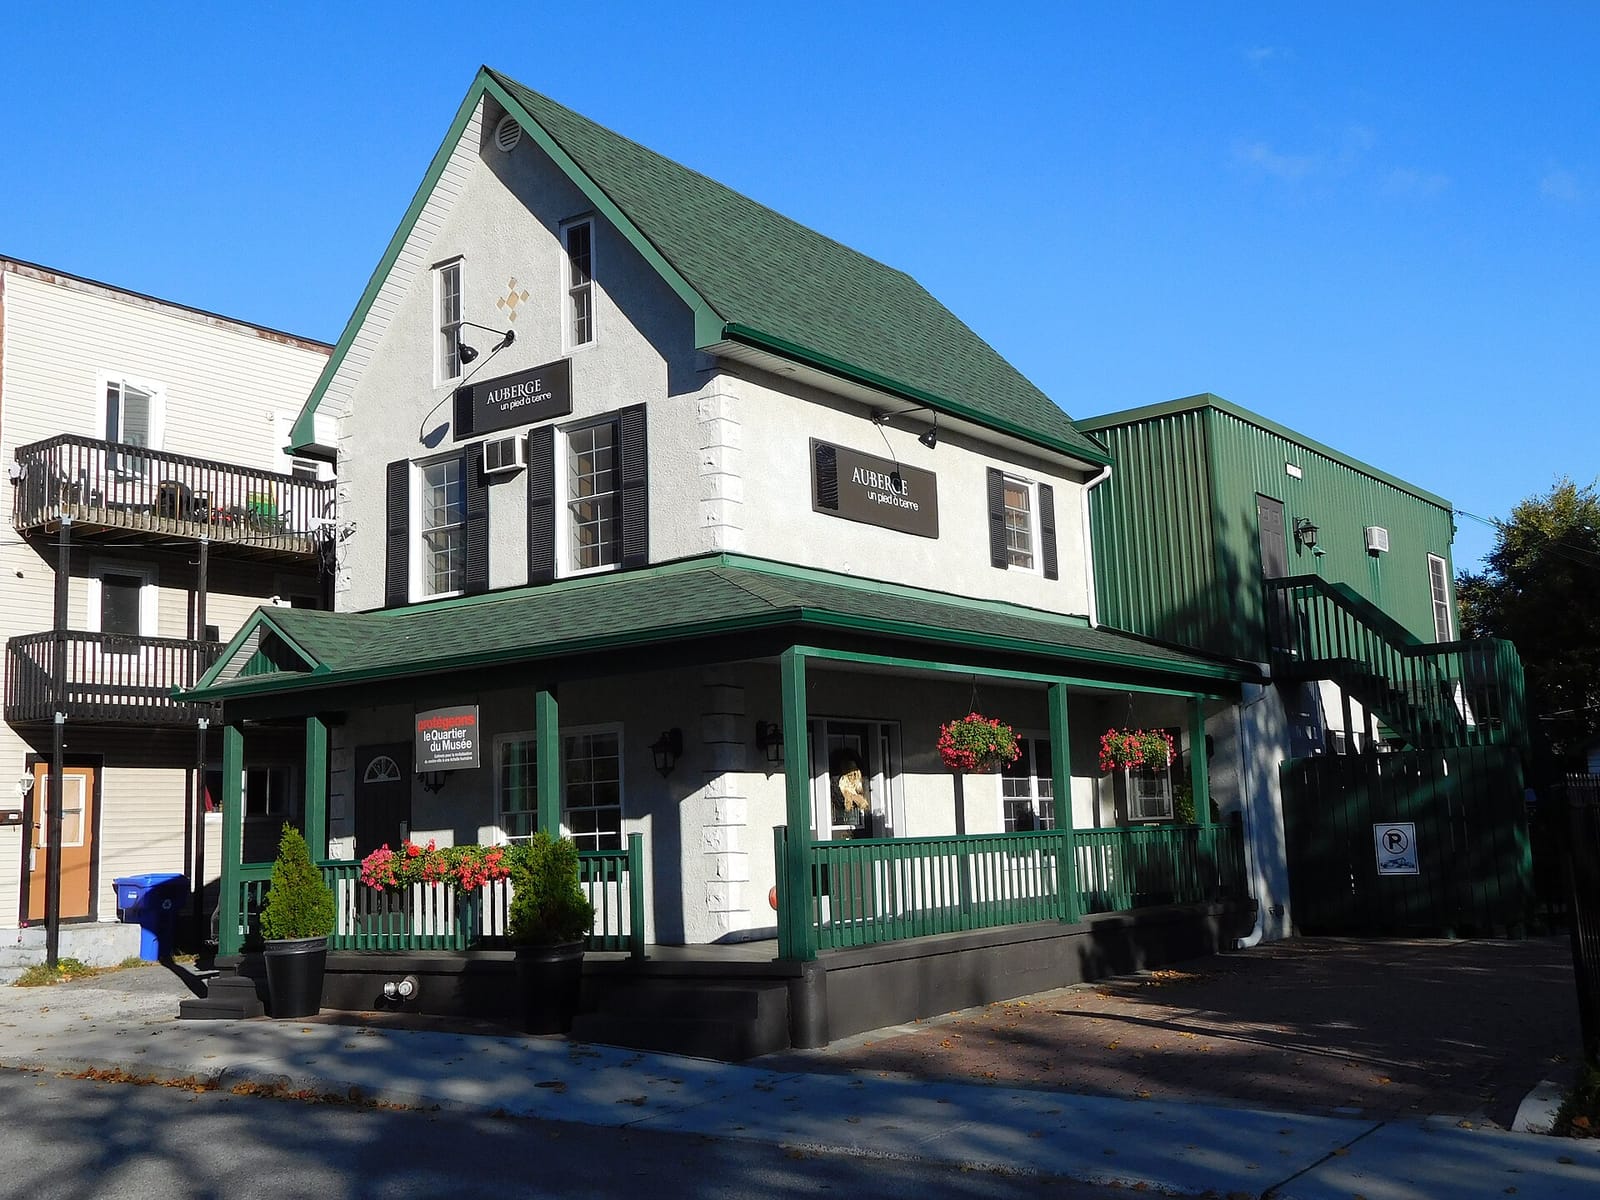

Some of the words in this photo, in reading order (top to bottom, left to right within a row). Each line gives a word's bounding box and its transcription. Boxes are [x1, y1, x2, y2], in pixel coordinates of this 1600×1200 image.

[486, 379, 541, 405] AUBERGE
[500, 402, 509, 411] un
[510, 397, 525, 410] pied
[532, 392, 552, 403] terre
[867, 491, 877, 500] un
[878, 493, 892, 504] pied
[899, 498, 919, 511] terre
[423, 731, 431, 742] le
[431, 728, 467, 741] Quartier
[430, 741, 441, 752] du
[442, 738, 472, 751] Musée
